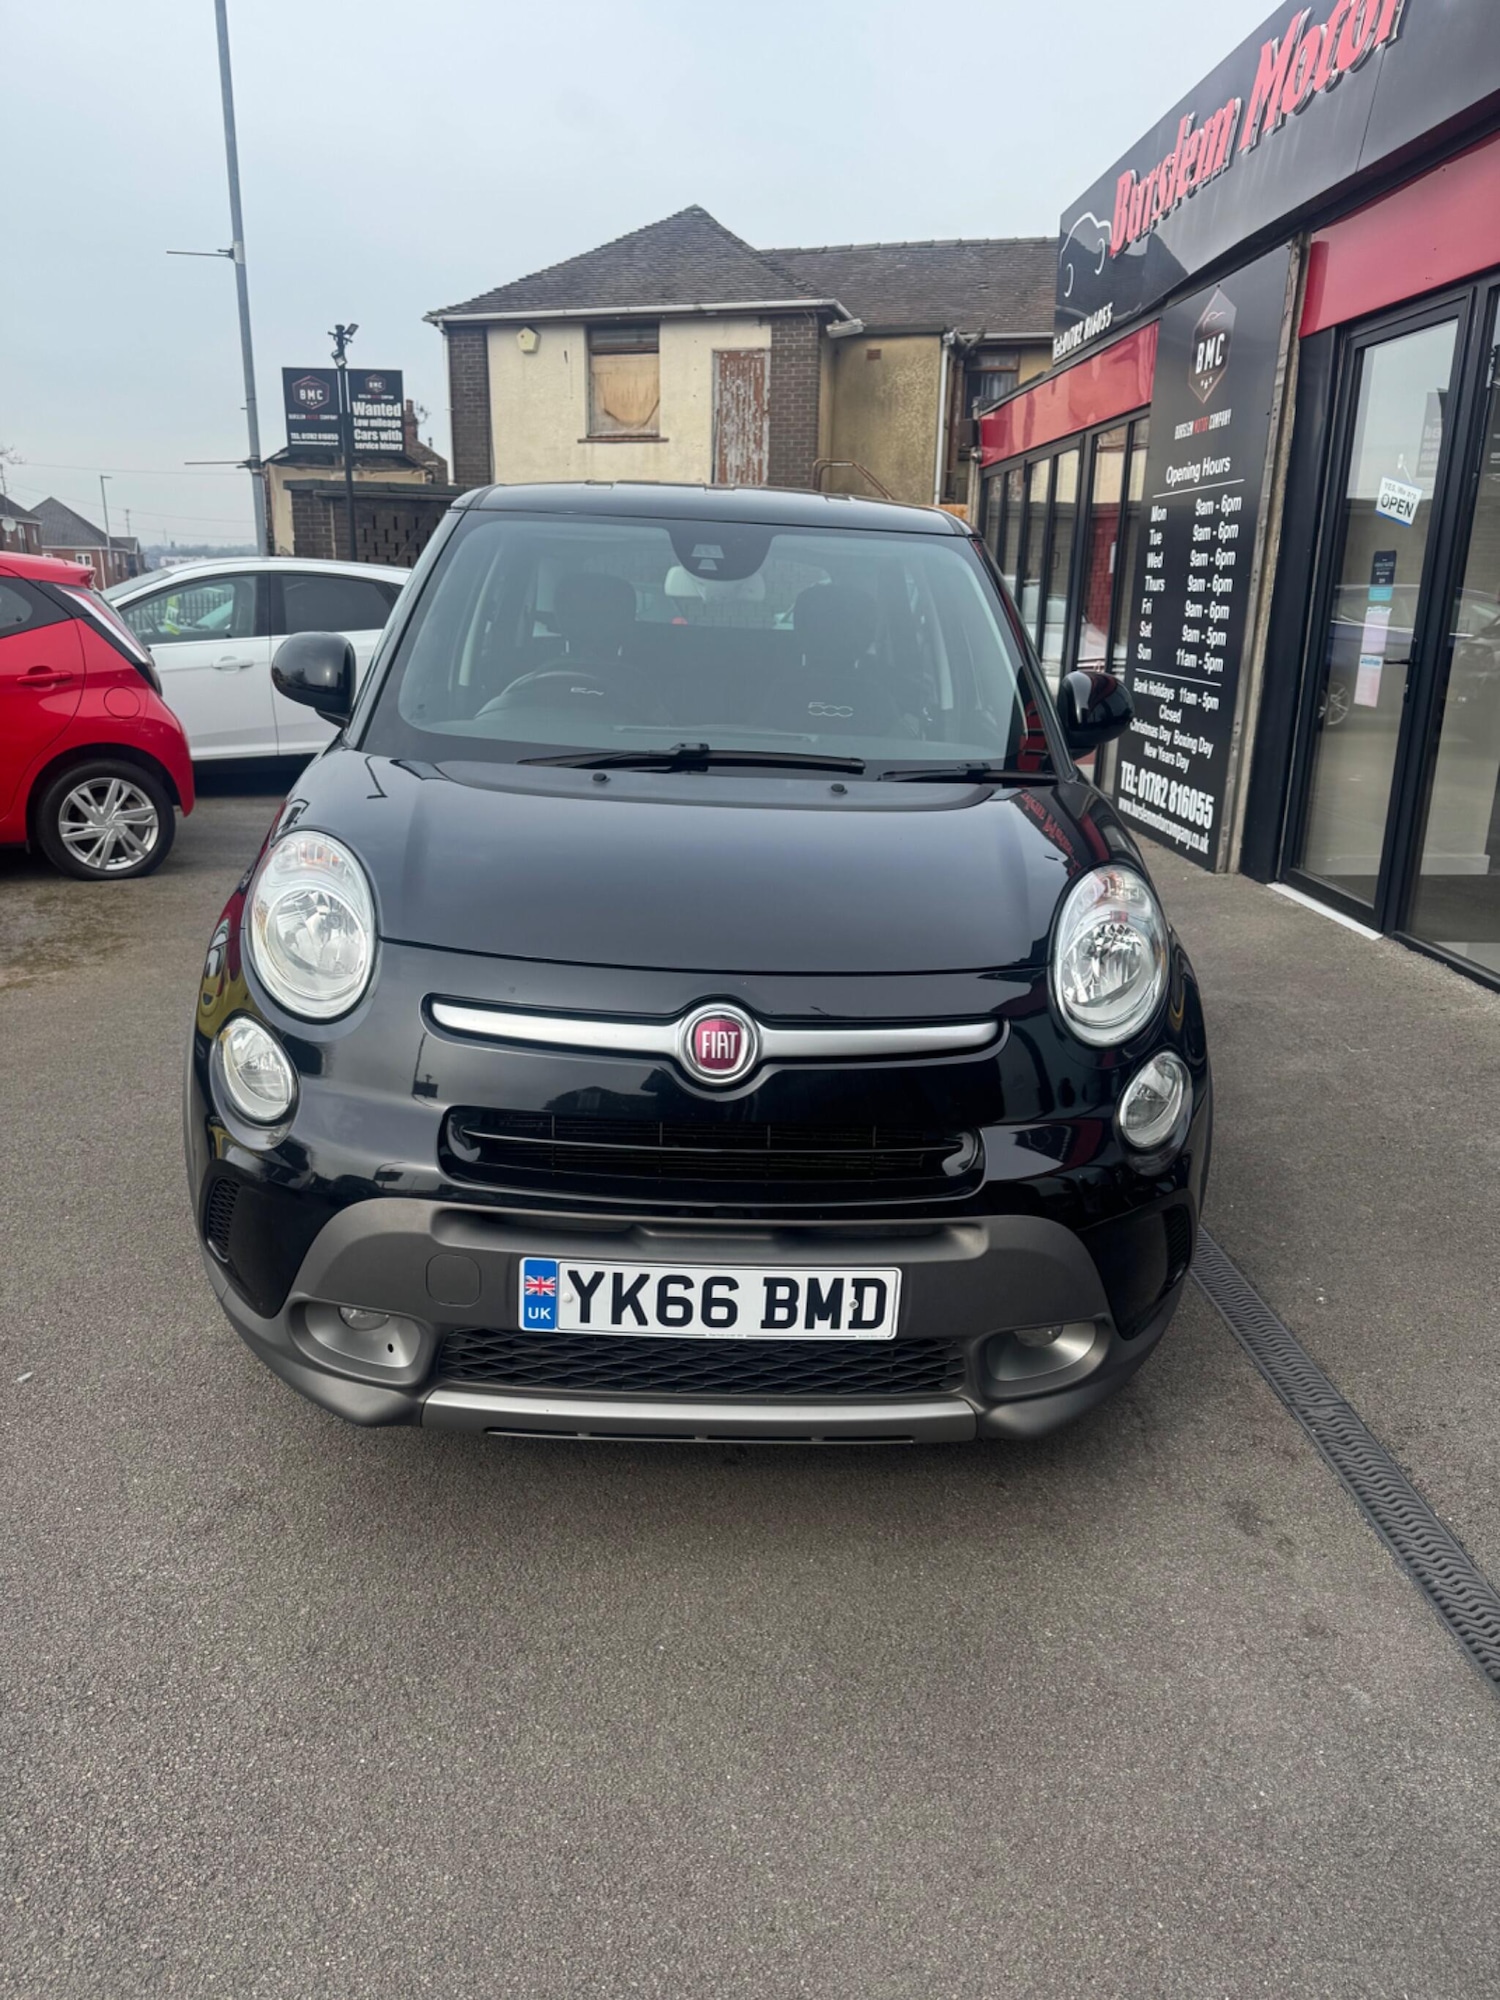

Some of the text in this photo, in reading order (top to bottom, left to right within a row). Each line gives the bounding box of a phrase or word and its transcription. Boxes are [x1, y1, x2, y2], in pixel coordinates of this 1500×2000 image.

[1109, 97, 1241, 259] Burslem
[1195, 333, 1225, 374] BMC
[299, 389, 323, 400] BMC
[352, 401, 402, 417] Wanted
[353, 417, 401, 429] Low mileage
[354, 428, 403, 441] Cars with
[354, 442, 403, 451] service history
[1166, 456, 1231, 487] Opening Hours
[1151, 505, 1167, 522] Mon
[1195, 499, 1214, 516] 9am
[1221, 494, 1242, 517] 6pm
[1380, 493, 1414, 518] OPEN
[1150, 529, 1163, 545] Tue
[1192, 524, 1211, 542] 9am
[1218, 521, 1239, 544] 6pm
[1147, 552, 1164, 568] Wed
[1190, 549, 1208, 567] 9am
[1215, 548, 1236, 571] 6pm
[1145, 575, 1165, 592] Thurs
[1187, 574, 1205, 592] 9am
[1212, 574, 1233, 596] 6pm
[1141, 598, 1152, 614] Fri
[1184, 600, 1203, 618] 9am
[1209, 601, 1230, 623] 6pm
[1139, 621, 1152, 638] Sat
[1182, 624, 1200, 643] 9am
[1206, 627, 1227, 649] 5pm
[1137, 643, 1151, 661] Sun
[1176, 648, 1197, 668] 11am
[1203, 652, 1224, 675] 5pm
[1133, 677, 1148, 695] Bank
[1149, 681, 1175, 702] Holidays
[1179, 687, 1197, 706] 11am
[1202, 692, 1219, 712] 5pm
[1158, 704, 1182, 724] Closed
[1130, 717, 1214, 759] Christmas Day Boxing Day
[1144, 741, 1190, 774] New Years Day
[1120, 760, 1215, 830] TEL: 01782 816055
[701, 1030, 738, 1060] FIAT
[528, 1306, 551, 1320] UK
[567, 1270, 887, 1330] YK66 BMD
